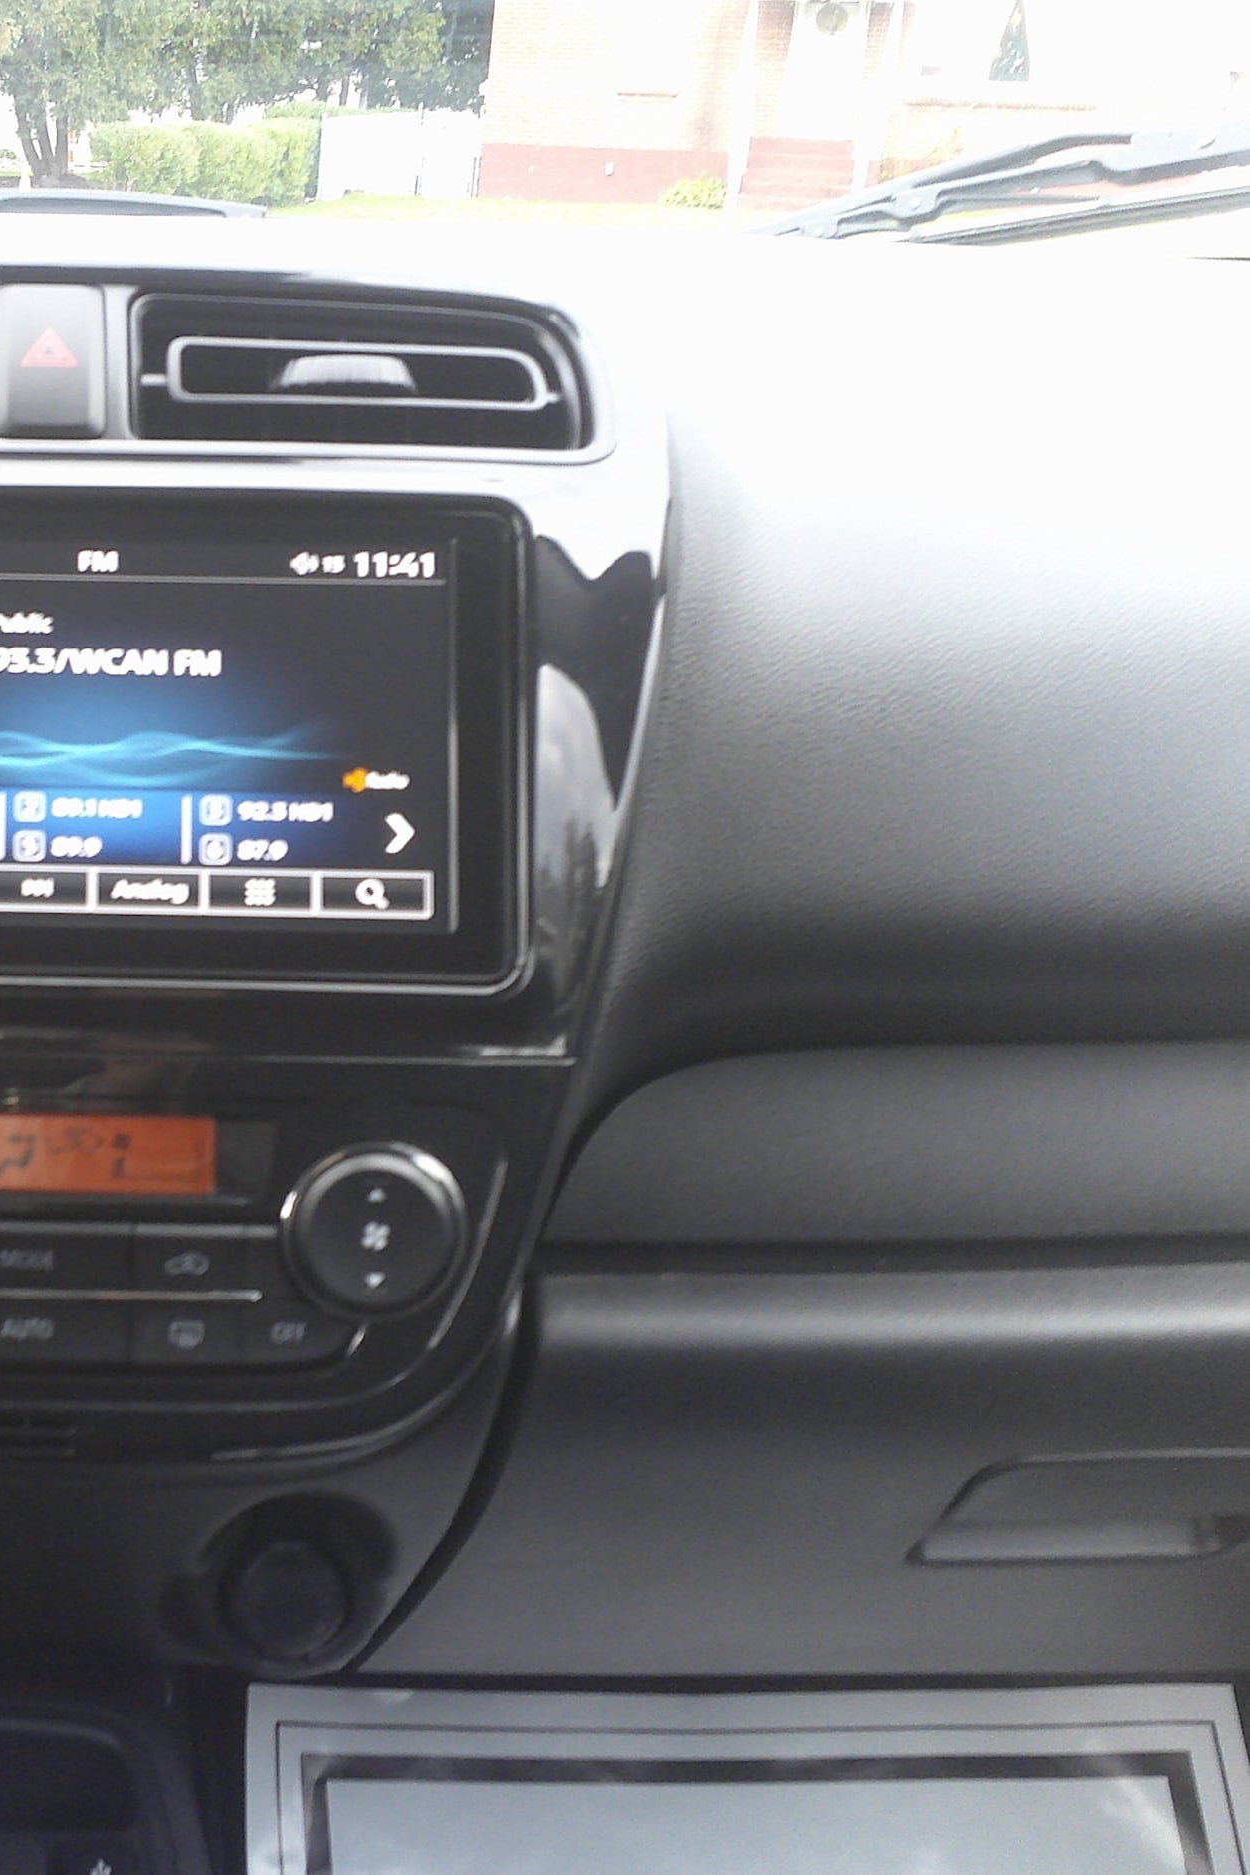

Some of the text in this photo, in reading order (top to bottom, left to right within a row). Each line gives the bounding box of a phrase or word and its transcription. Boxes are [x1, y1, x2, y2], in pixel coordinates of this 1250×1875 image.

[78, 551, 119, 572] FM
[355, 552, 434, 577] 11:41
[174, 649, 221, 676] FM
